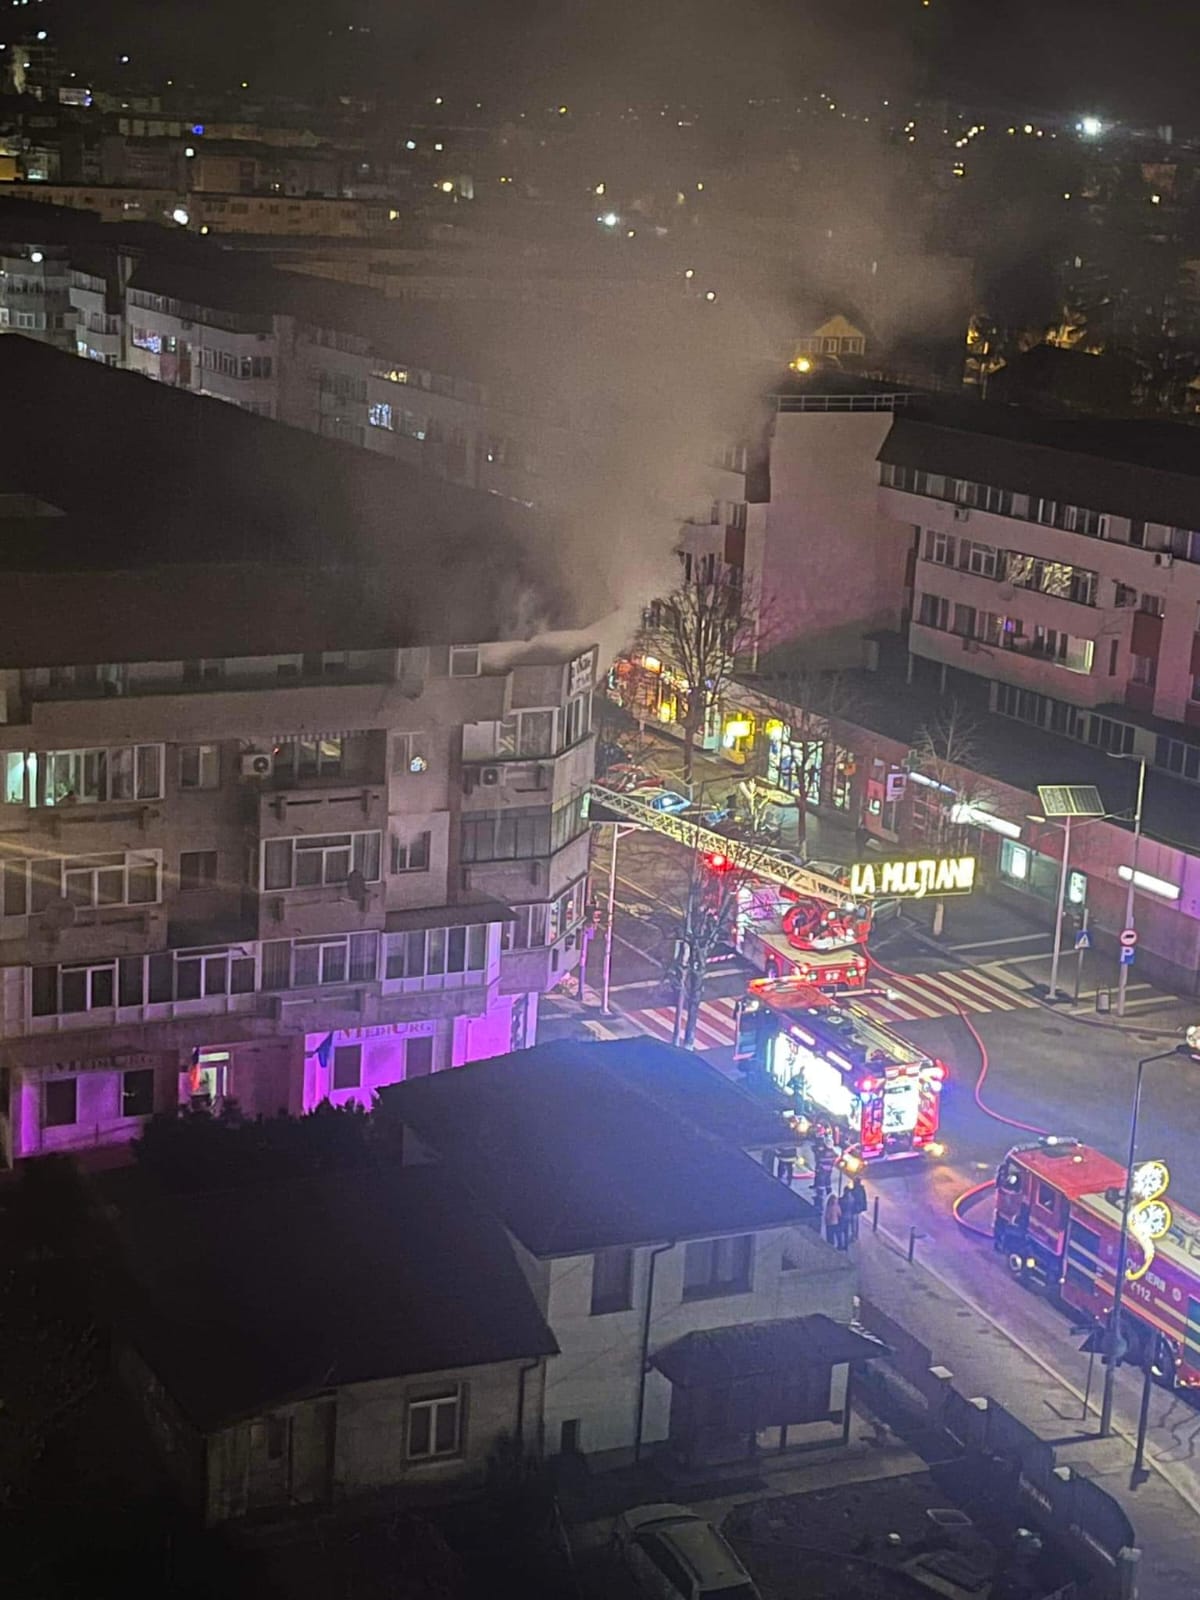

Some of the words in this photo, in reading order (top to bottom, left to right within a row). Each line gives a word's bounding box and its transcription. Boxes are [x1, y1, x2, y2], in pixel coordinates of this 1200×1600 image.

[851, 864, 875, 893] LA
[936, 857, 975, 889] ANI
[1120, 946, 1134, 962] P
